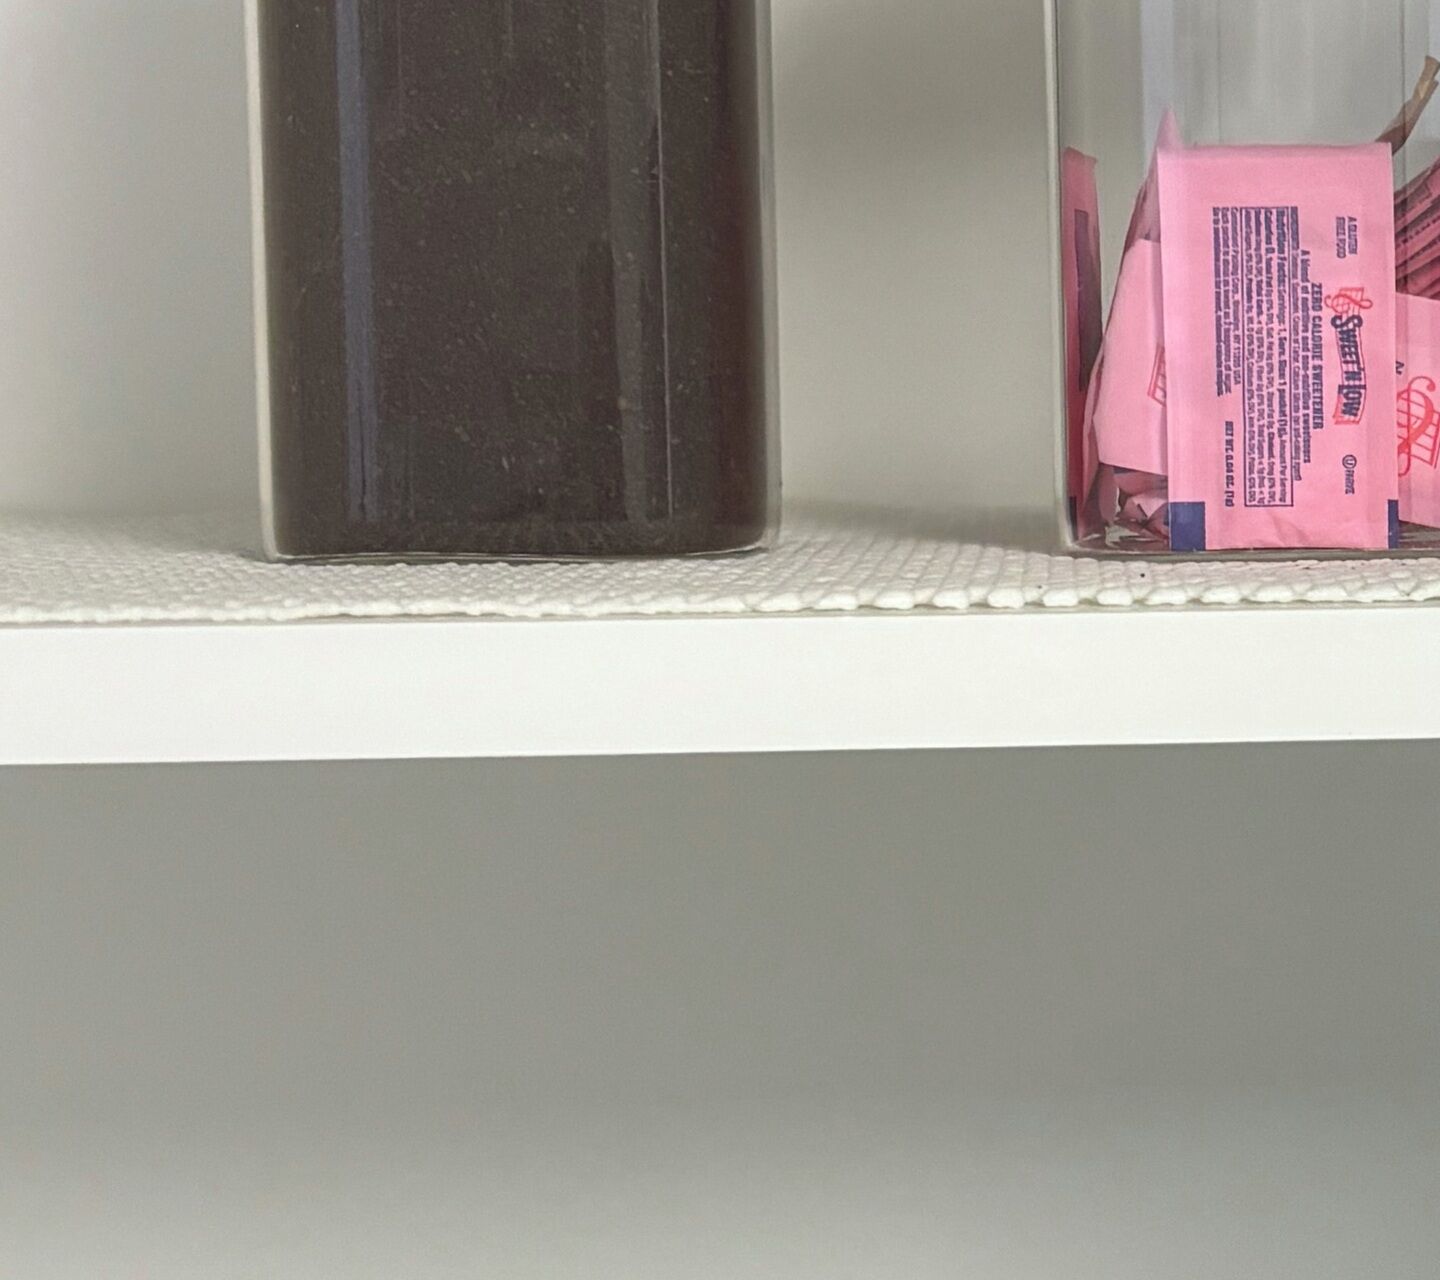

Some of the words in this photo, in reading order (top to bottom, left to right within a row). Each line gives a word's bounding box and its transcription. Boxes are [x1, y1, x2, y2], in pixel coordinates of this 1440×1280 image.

[1301, 259, 1310, 283] blend
[1311, 283, 1322, 312] ZERO
[1302, 336, 1310, 352] and
[1312, 316, 1322, 361] CALORIE
[1313, 365, 1324, 429] SWEETENER
[1338, 384, 1366, 417] LOW
[1303, 413, 1311, 463] sweeteners
